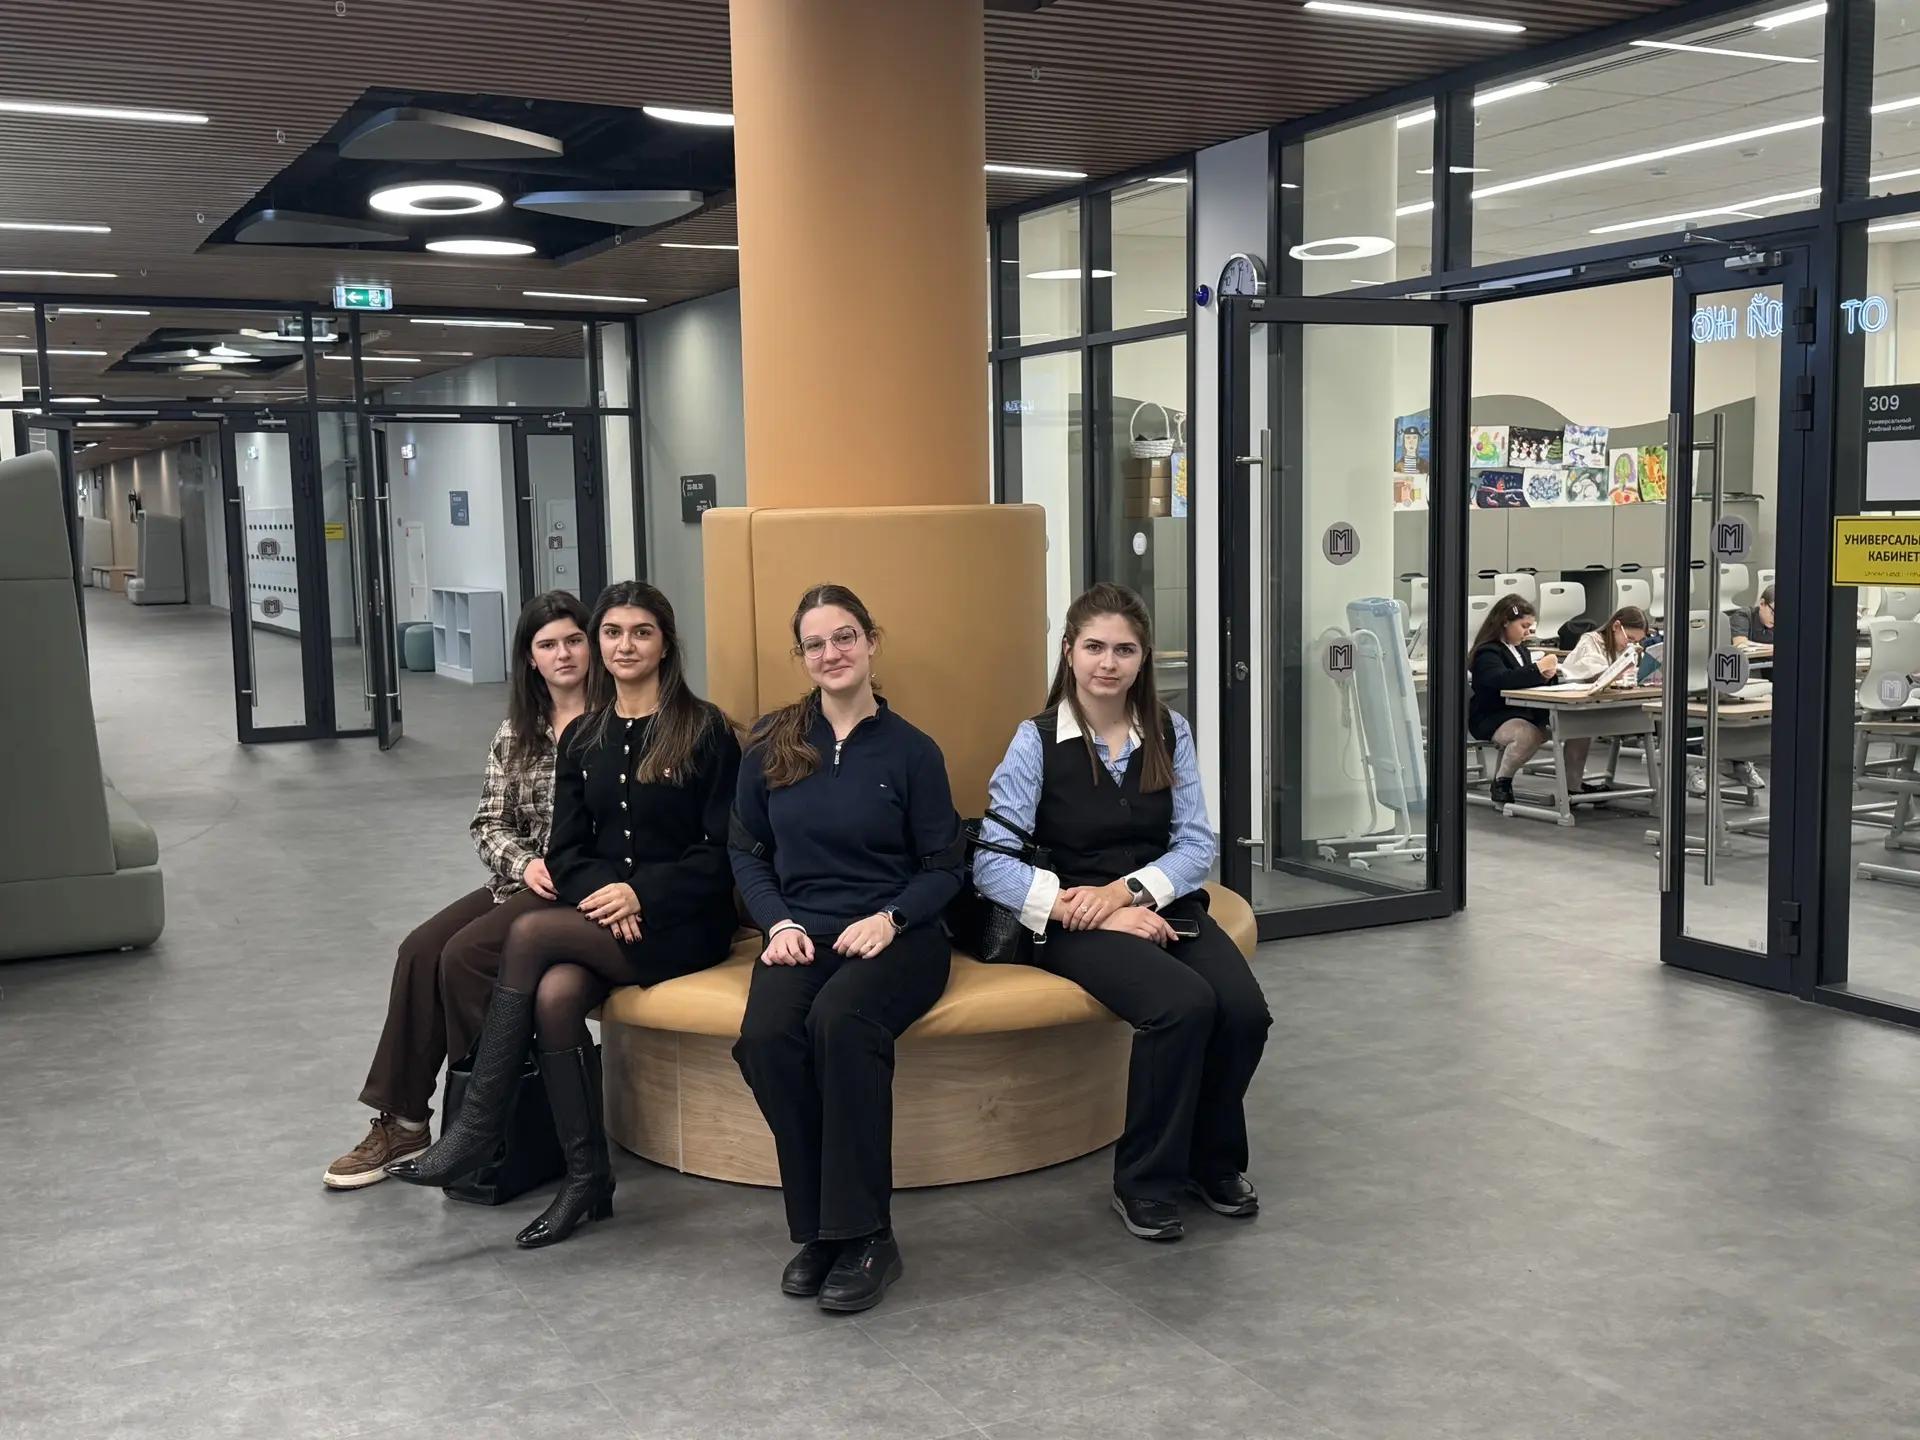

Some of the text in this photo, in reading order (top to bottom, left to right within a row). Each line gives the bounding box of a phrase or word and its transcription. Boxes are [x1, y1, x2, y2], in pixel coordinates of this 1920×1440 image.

[1869, 395, 1900, 412] 309
[1844, 534, 1920, 546] УНИВЕРСАЛЬ
[1868, 551, 1920, 562] КАБИНЕТ
